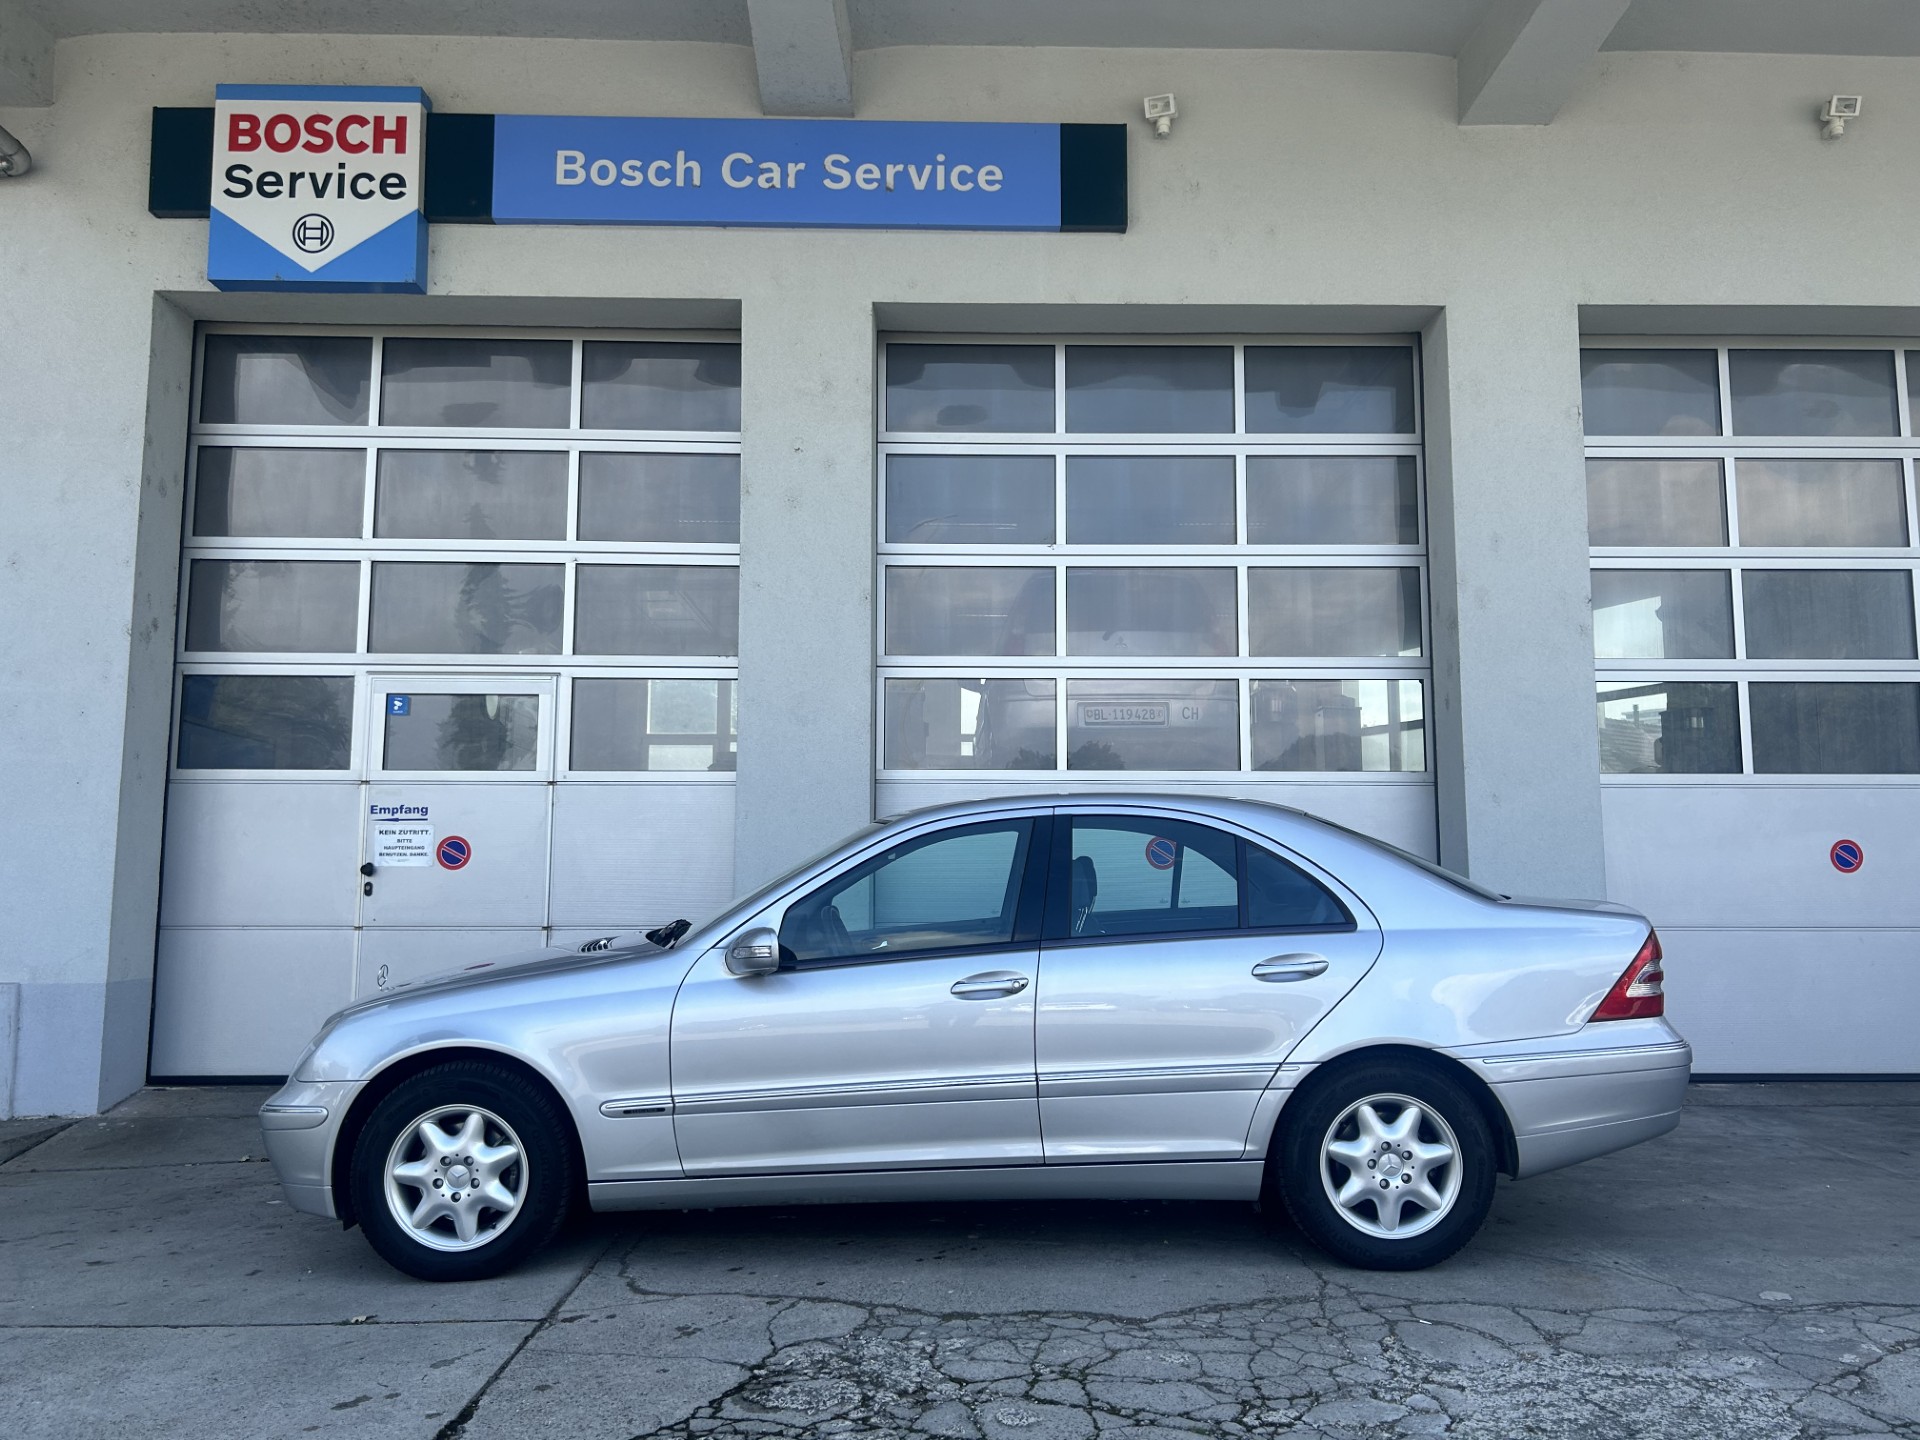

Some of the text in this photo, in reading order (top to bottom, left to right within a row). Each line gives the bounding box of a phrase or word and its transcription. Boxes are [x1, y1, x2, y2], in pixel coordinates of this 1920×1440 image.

[227, 113, 408, 154] BOSCH
[222, 162, 408, 200] Service
[555, 150, 1004, 192] Bosch Car Service
[1182, 706, 1199, 720] CH
[370, 804, 429, 816] Empfang
